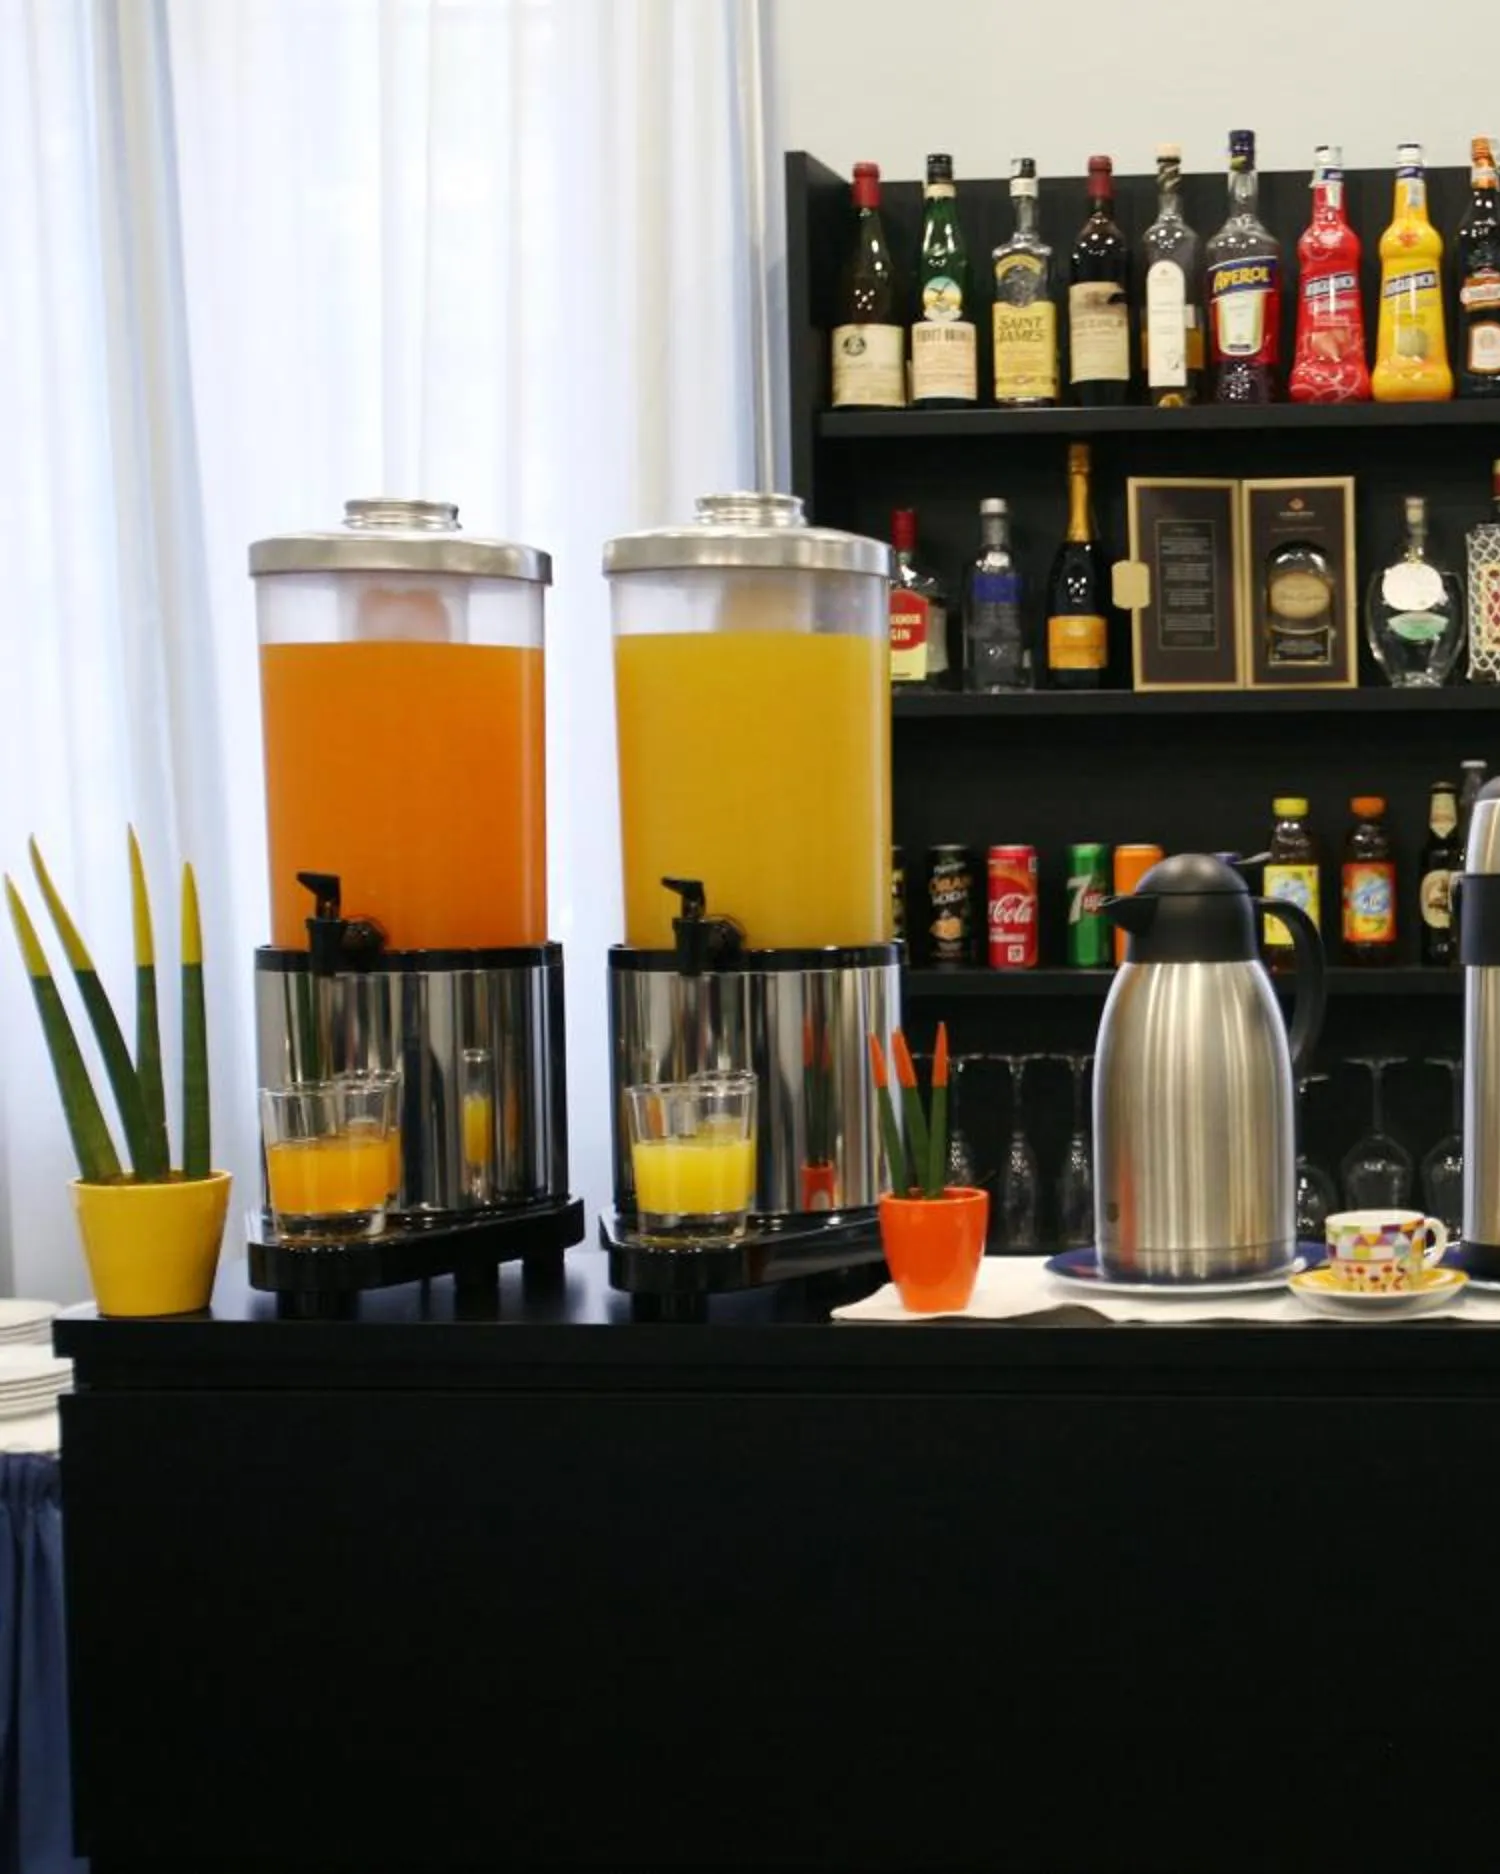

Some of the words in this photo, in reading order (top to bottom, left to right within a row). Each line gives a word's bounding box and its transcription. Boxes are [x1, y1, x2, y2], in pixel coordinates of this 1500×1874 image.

[1214, 266, 1270, 292] APEROL
[998, 316, 1043, 332] SAINT
[997, 331, 1046, 345] JAMES
